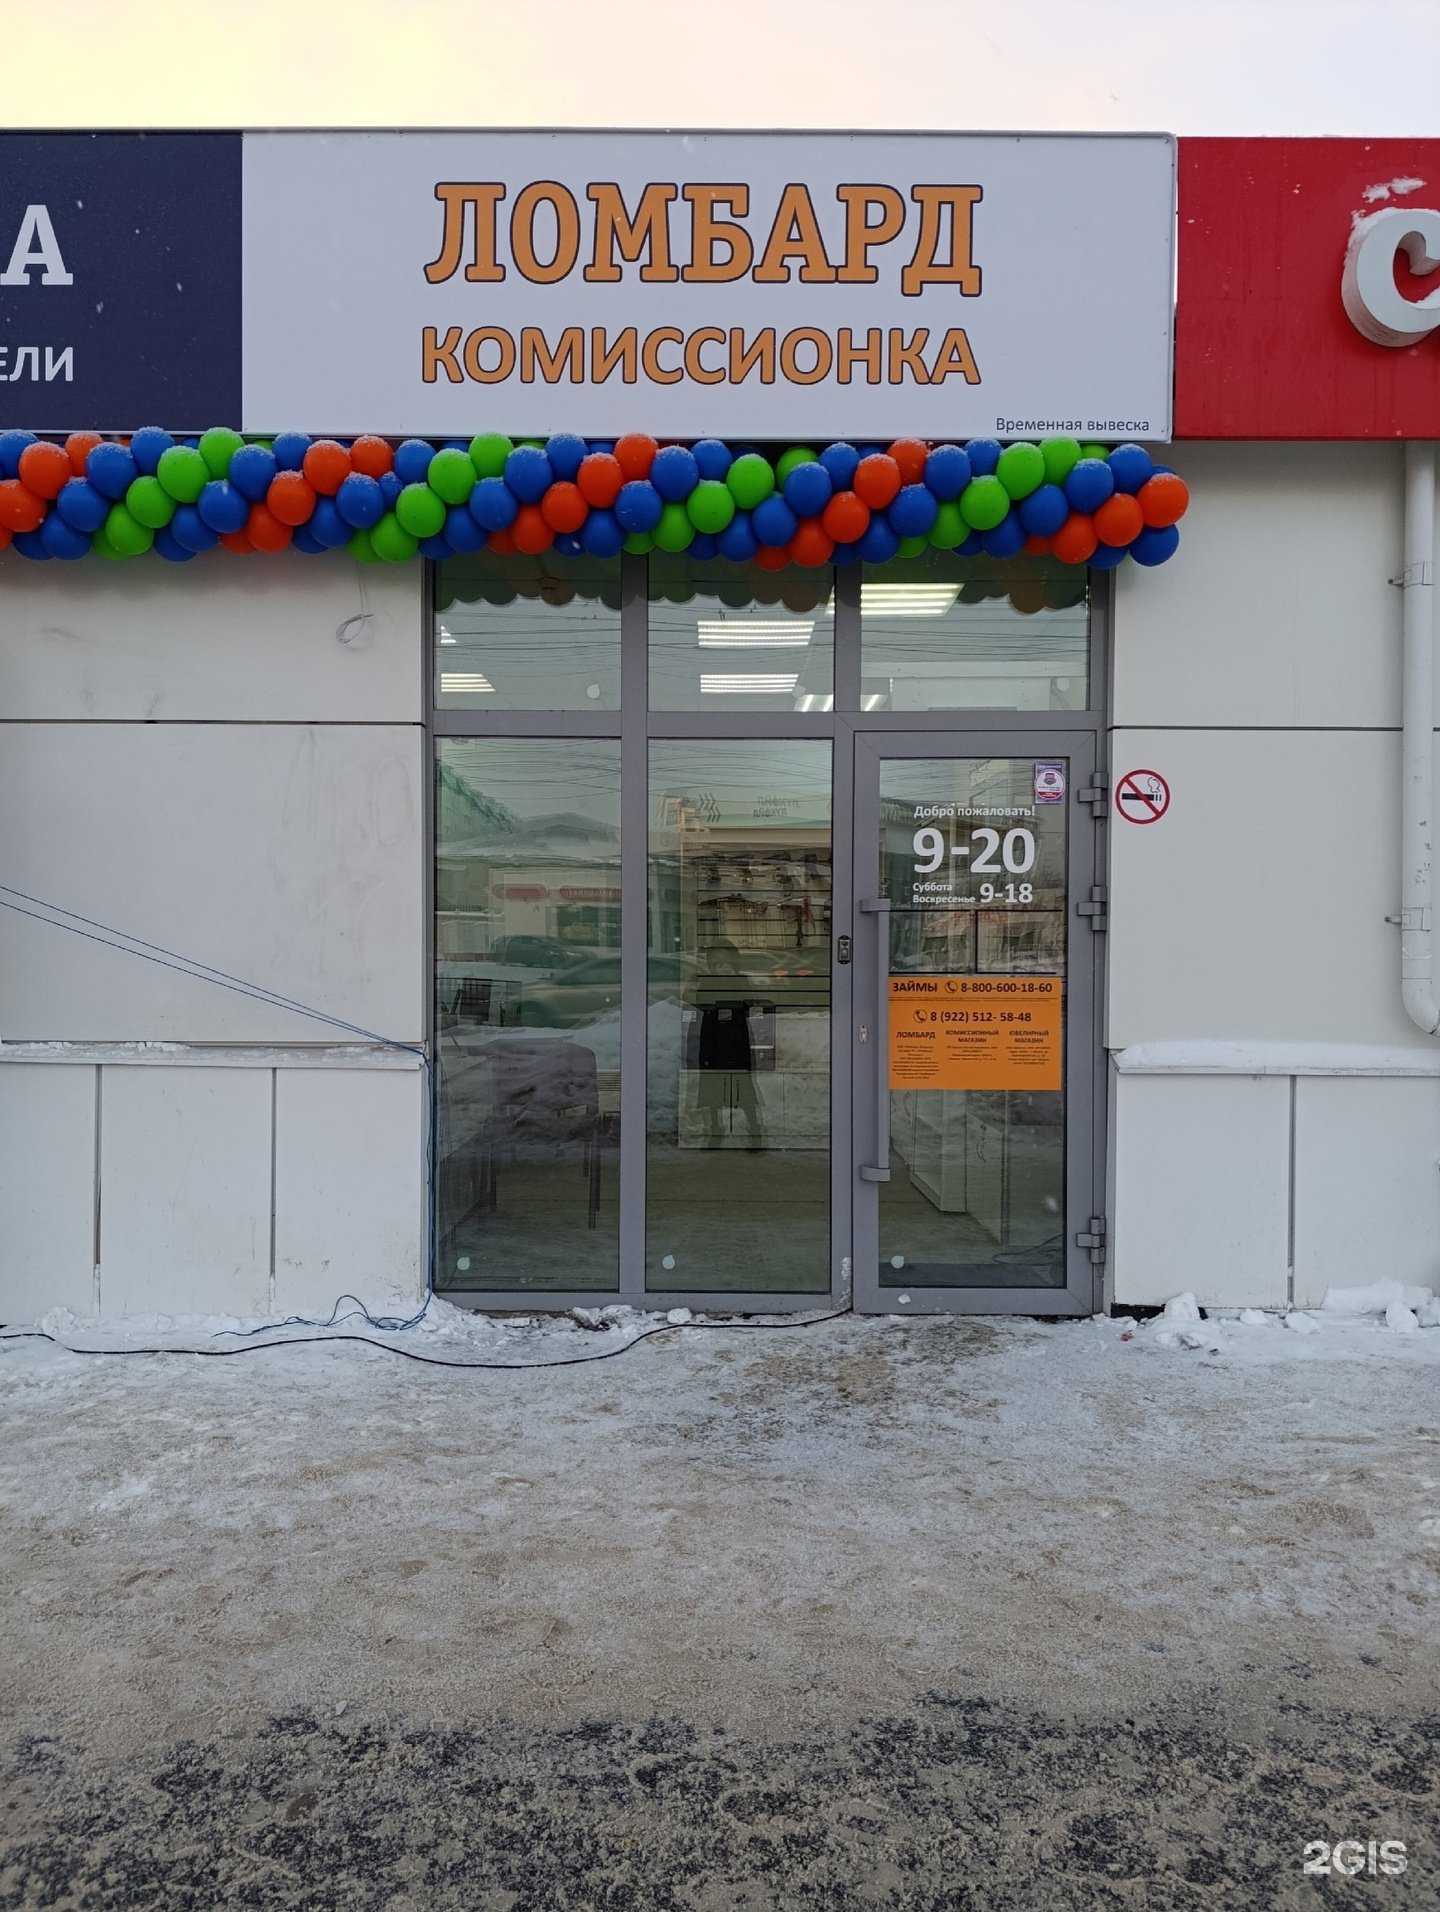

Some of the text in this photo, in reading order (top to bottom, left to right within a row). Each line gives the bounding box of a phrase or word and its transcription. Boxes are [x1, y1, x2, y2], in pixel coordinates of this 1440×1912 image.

[423, 180, 983, 298] ЛОМБАРД
[422, 326, 982, 385] КОМИССИОНКА
[996, 417, 1150, 433] Временная вывеска
[914, 805, 1035, 818] Добро пожаловать!
[912, 827, 1036, 874] 9-20
[912, 882, 953, 895] Суббота
[912, 882, 1034, 905] Воскресенье 9-18
[893, 980, 1053, 993] ЗАЙМЫ 8-800-600-18-60
[930, 1012, 937, 1022] 8
[940, 1010, 969, 1023] (922)
[1000, 1012, 1032, 1022] 58-48
[896, 1031, 936, 1040] ЛОМБАРД
